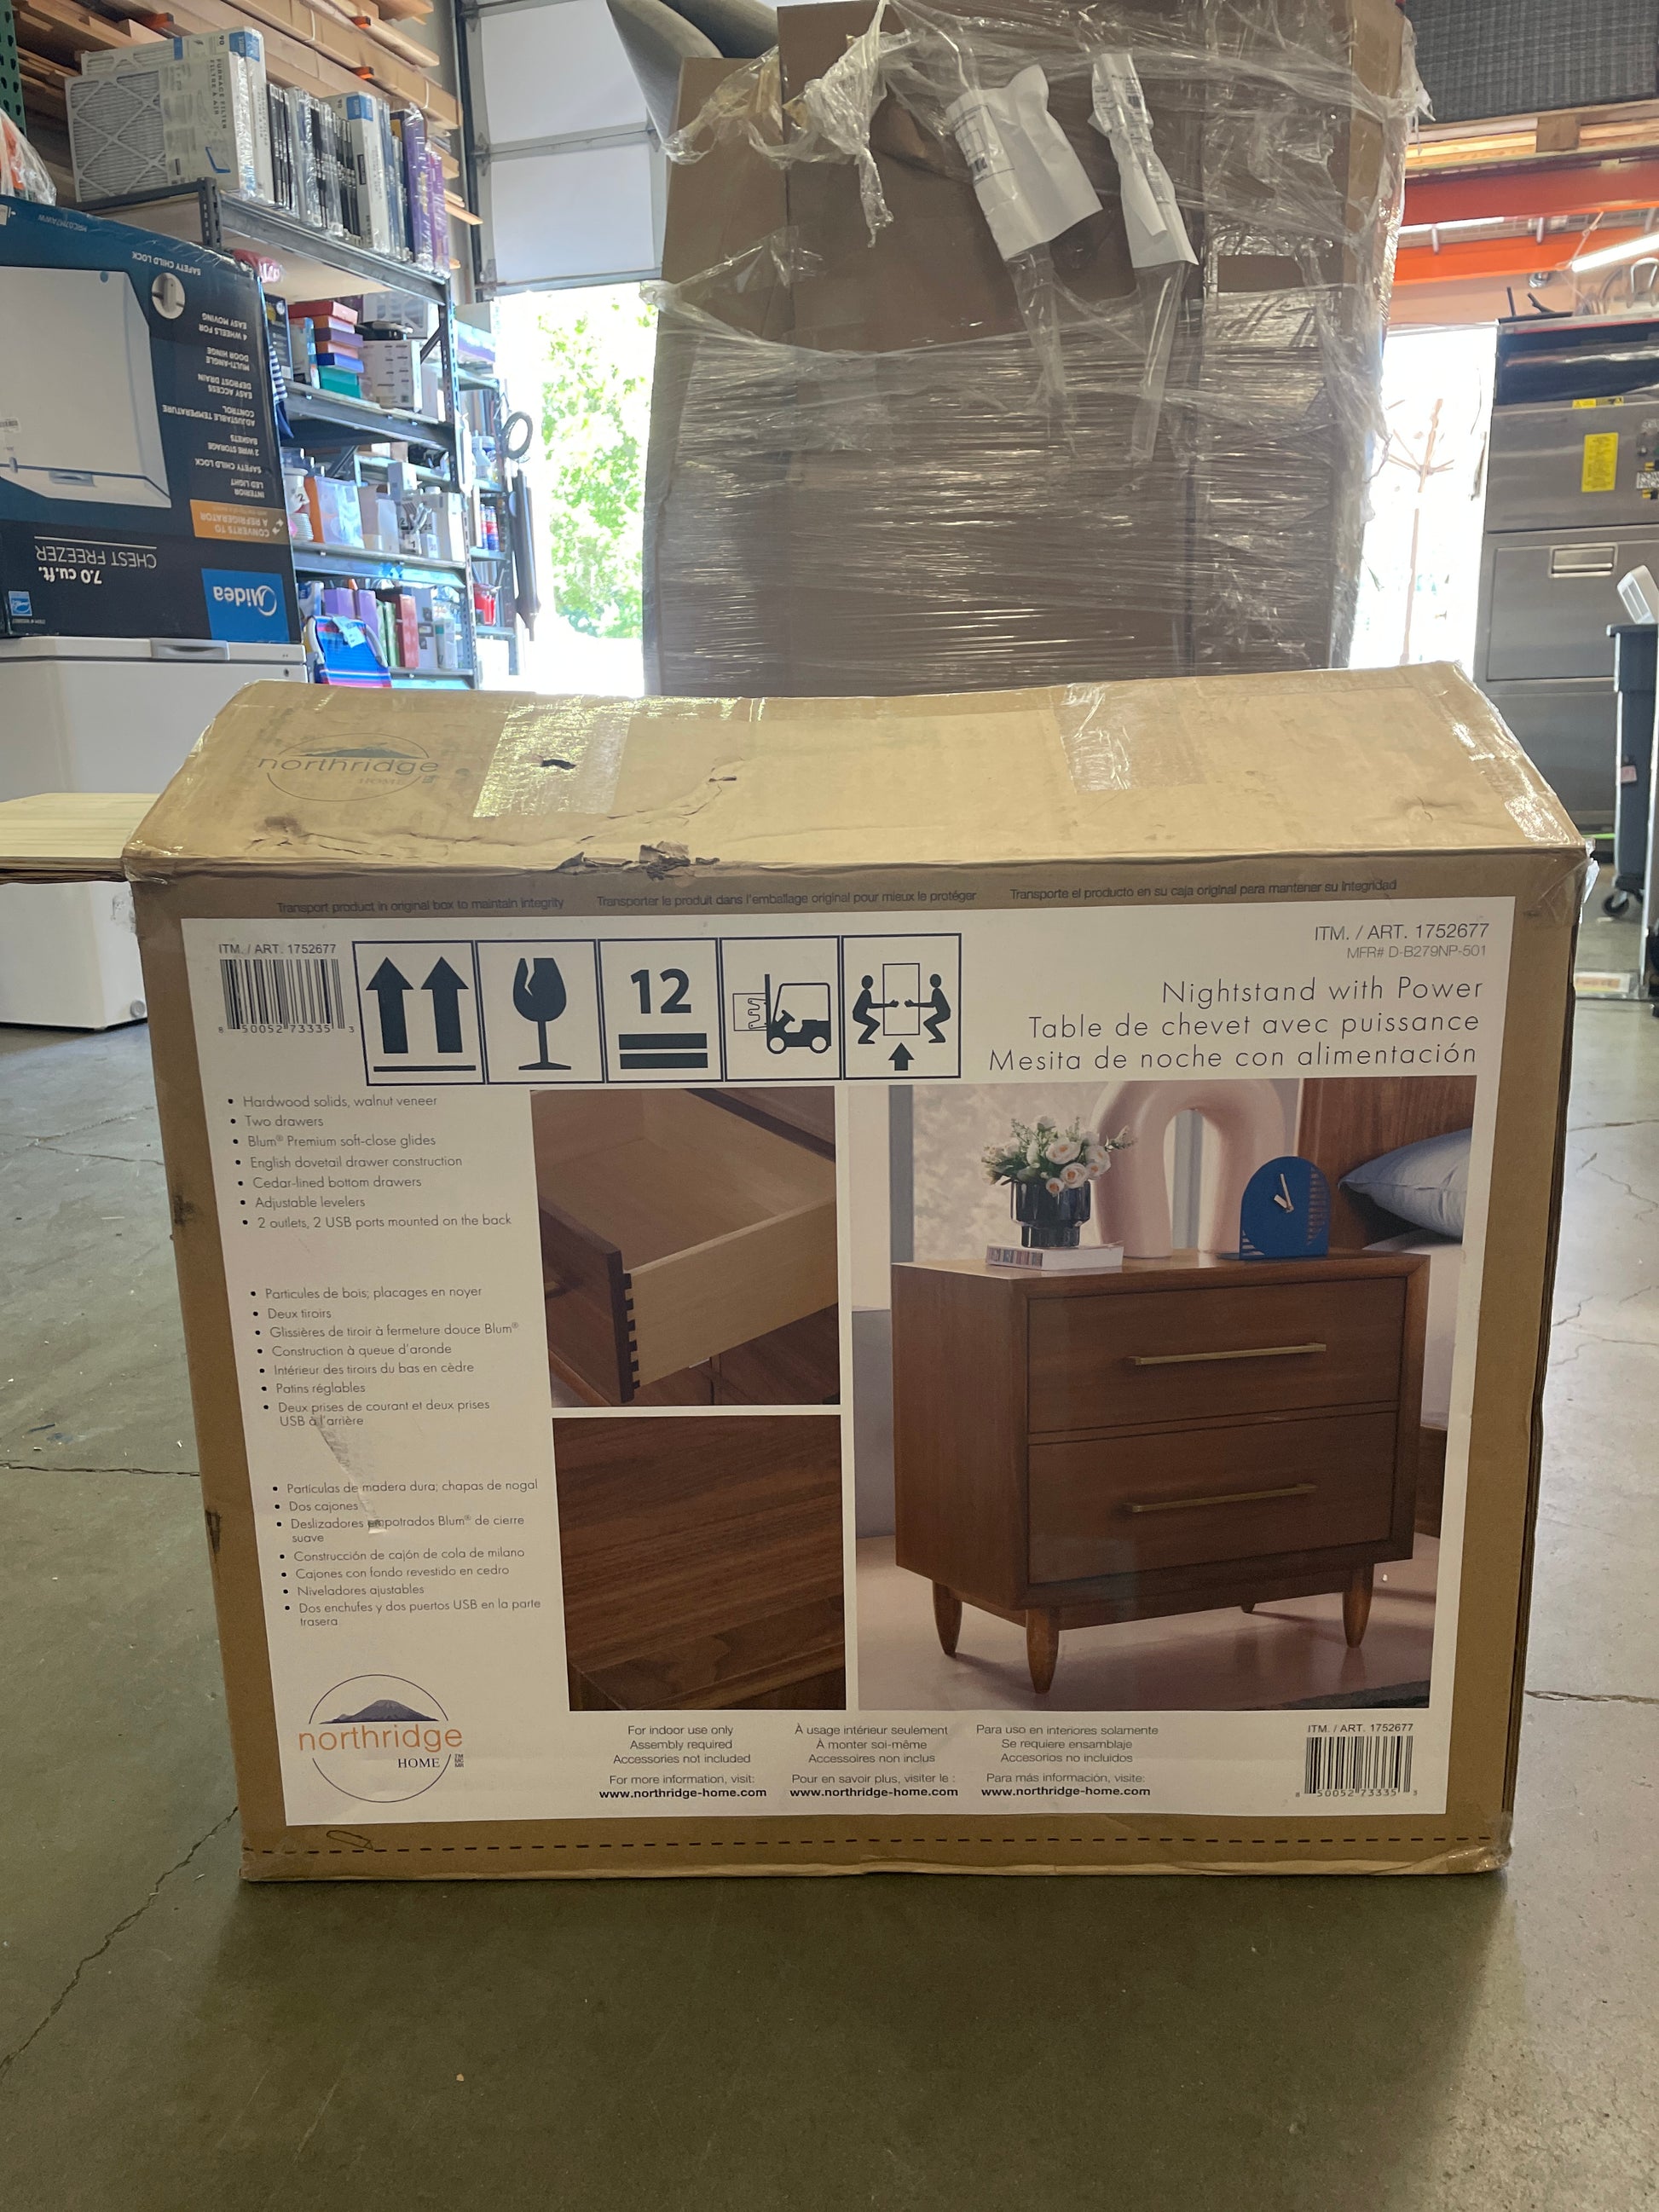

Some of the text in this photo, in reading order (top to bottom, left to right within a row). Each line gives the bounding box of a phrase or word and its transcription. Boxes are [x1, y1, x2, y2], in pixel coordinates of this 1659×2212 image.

[132, 251, 201, 276] SAFETY CHILD LOCK
[199, 324, 213, 334] FOR
[202, 313, 247, 331] EASY MOVING
[214, 327, 242, 340] WHEELS
[207, 347, 249, 361] DOOR HINGE
[206, 356, 251, 372] MULTI-ANGLE
[198, 373, 252, 390] DEFROST DRAIN
[208, 384, 253, 400] EASY ACCESS
[162, 405, 256, 427] ADJUSTABLE TEMPERATURE
[223, 406, 255, 417] CONTROL
[208, 442, 238, 453] STORAGE
[230, 435, 258, 446] BASKETS
[238, 447, 255, 456] WIRE
[194, 459, 263, 474] SAFETY CHILD LOCK
[231, 479, 264, 489] LED LIGHT
[234, 488, 265, 499] INTERIOR
[200, 513, 269, 528] A REFRIGERATOR
[215, 524, 270, 538] CONVERTS TO
[35, 546, 157, 569] CHEST FREEZER
[38, 567, 102, 585] 7.0 cu.ft.
[213, 585, 278, 617] Midea
[257, 759, 439, 776] northridge
[1009, 879, 1397, 900] Transporte el producto en su caja original para mantener su integridad
[276, 897, 564, 915] Transport product in original box to maintain integrity
[596, 890, 977, 908] Transporter le produit dans l'emballage original pour mieux le protéger
[1315, 926, 1349, 941] ITM.
[1367, 924, 1408, 939] ART.
[1416, 922, 1489, 939] 1752677
[287, 944, 336, 954] 1752677
[1347, 944, 1486, 959] MFR# D-B279NP-501
[630, 968, 692, 1014] 12
[1163, 975, 1483, 1009] Nightstand with Power
[1028, 1013, 1478, 1038] Table de chevet avec puissance
[990, 1042, 1475, 1071] Mesita de noche con alimentación
[243, 1094, 436, 1108] Hardwood solids, walnut veneer
[245, 1115, 324, 1127] Two drawers
[286, 1135, 337, 1147] Premium
[340, 1134, 396, 1146] soft-close
[400, 1133, 436, 1149] glides
[250, 1155, 462, 1171] English dovetail drawer construction
[252, 1175, 422, 1188] Cedar-lined bottom drawers
[255, 1195, 365, 1210] Adjustable levelers
[265, 1287, 320, 1299] Particules
[322, 1286, 338, 1299] de
[373, 1286, 428, 1301] placages
[431, 1289, 445, 1297] en
[449, 1288, 482, 1299] noyer
[268, 1308, 332, 1320] Deux tiroirs
[289, 1500, 358, 1514] Dos cajones
[297, 1583, 425, 1597] Niveladores ajustables
[627, 1725, 646, 1736] For
[650, 1725, 685, 1735] indoor
[711, 1725, 733, 1736] only
[795, 1723, 948, 1737] À usage intérieur seulement
[1371, 1723, 1413, 1732] 1752677
[298, 1724, 463, 1753] northridge
[629, 1740, 732, 1751] Assembly required
[397, 1758, 441, 1769] HOME
[598, 1788, 766, 1799] www.northridge-home.com
[789, 1788, 958, 1798] www.northridge-home.com
[981, 1786, 1150, 1797] www.northridge-home.com
